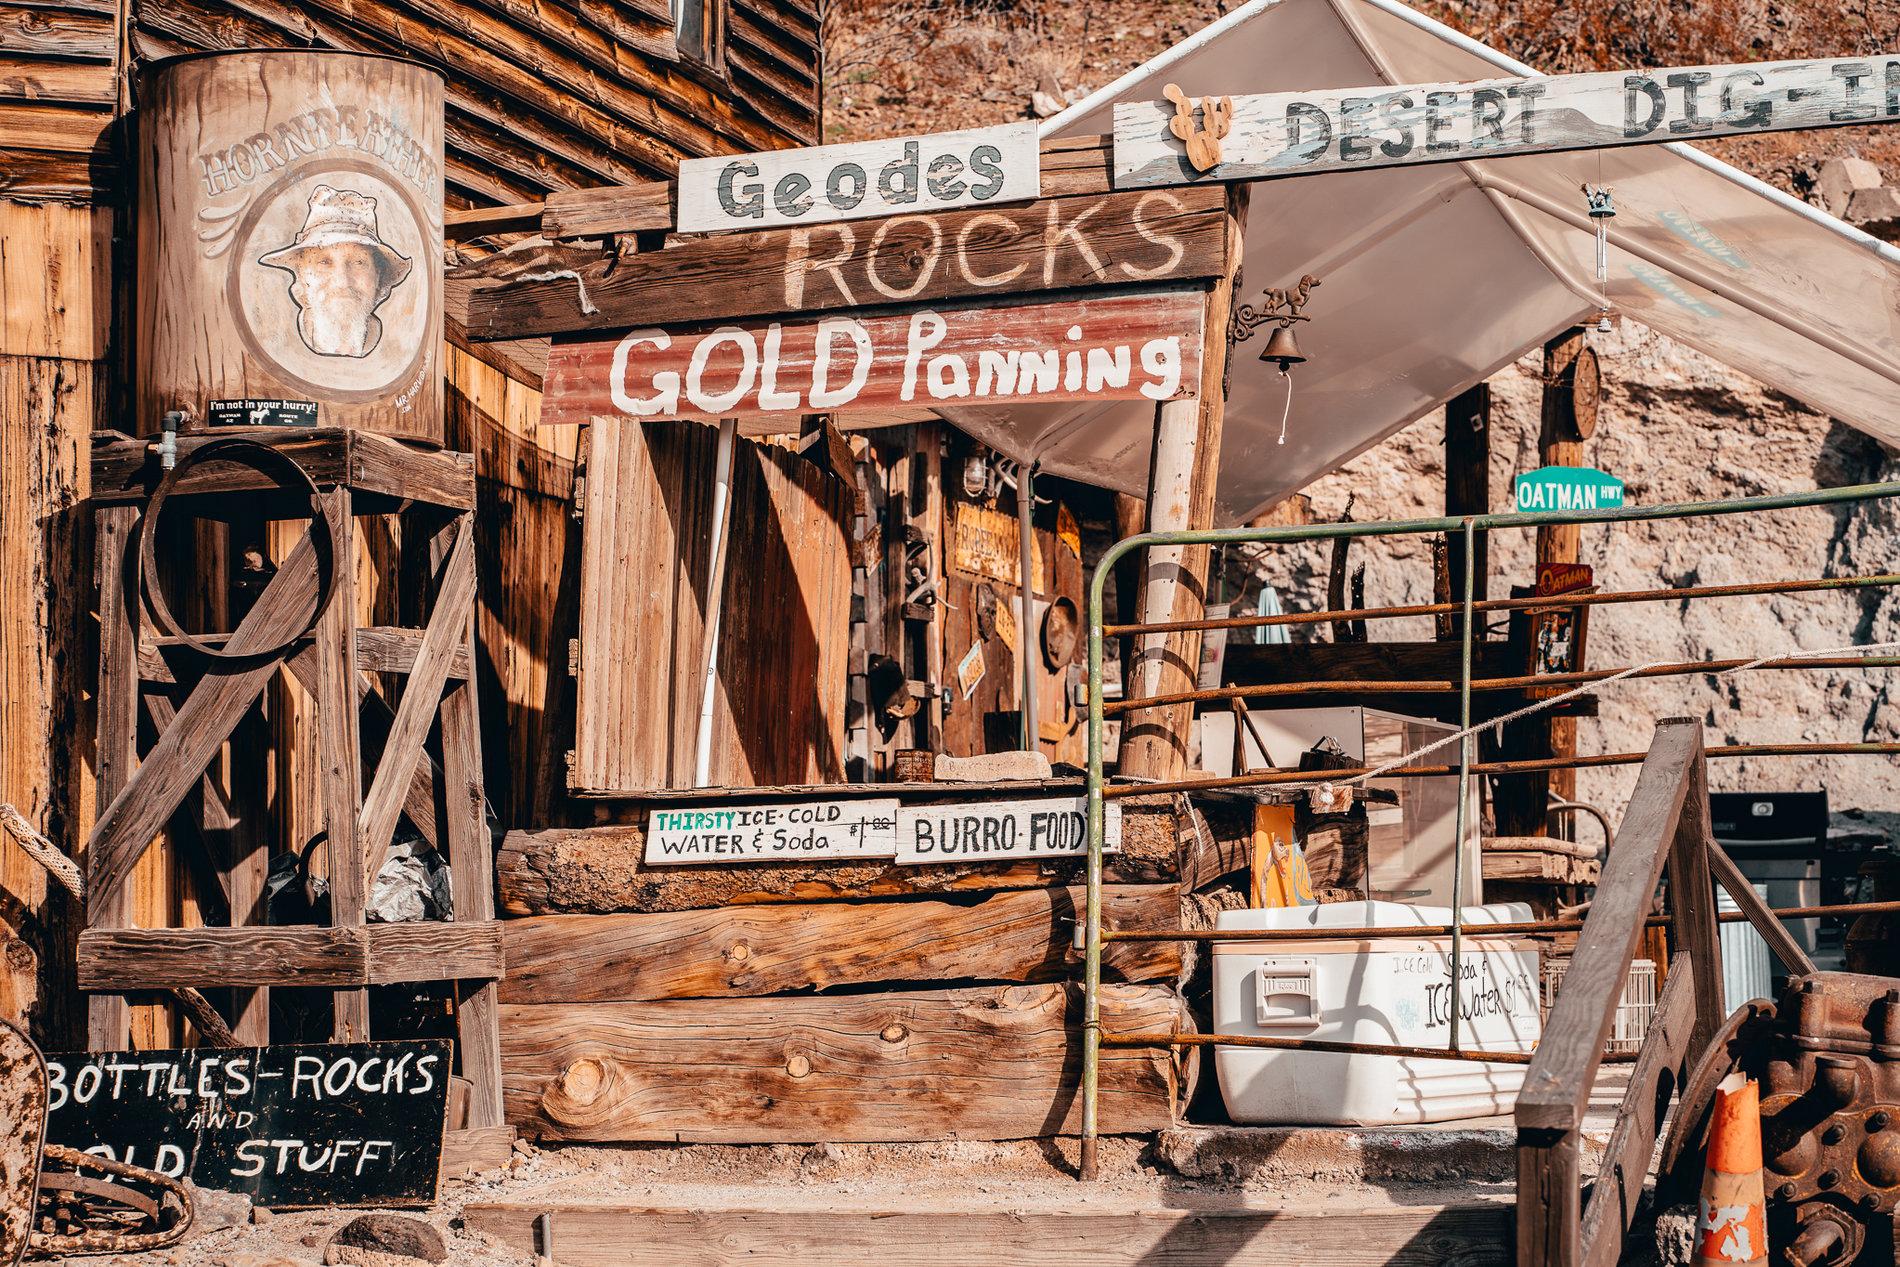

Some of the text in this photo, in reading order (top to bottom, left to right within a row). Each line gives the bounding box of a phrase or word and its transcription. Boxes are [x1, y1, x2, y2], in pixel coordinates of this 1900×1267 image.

[1286, 84, 1546, 164] DESERT
[717, 140, 1005, 219] Geodes
[784, 192, 1189, 309] ROCKS
[609, 316, 874, 416] GOLD
[210, 399, 317, 415] I'm not in your hurry!
[1519, 481, 1622, 510] OATMAN HWY
[1540, 568, 1589, 596] OATMAN
[656, 811, 736, 831] THIRSTY
[914, 813, 1017, 854] BURRO
[1029, 811, 1086, 852] FOOD
[661, 827, 829, 855] WATER & Soda
[292, 1052, 439, 1101] ROCKS
[186, 1112, 255, 1131] AND
[230, 1139, 393, 1177] STUFF
